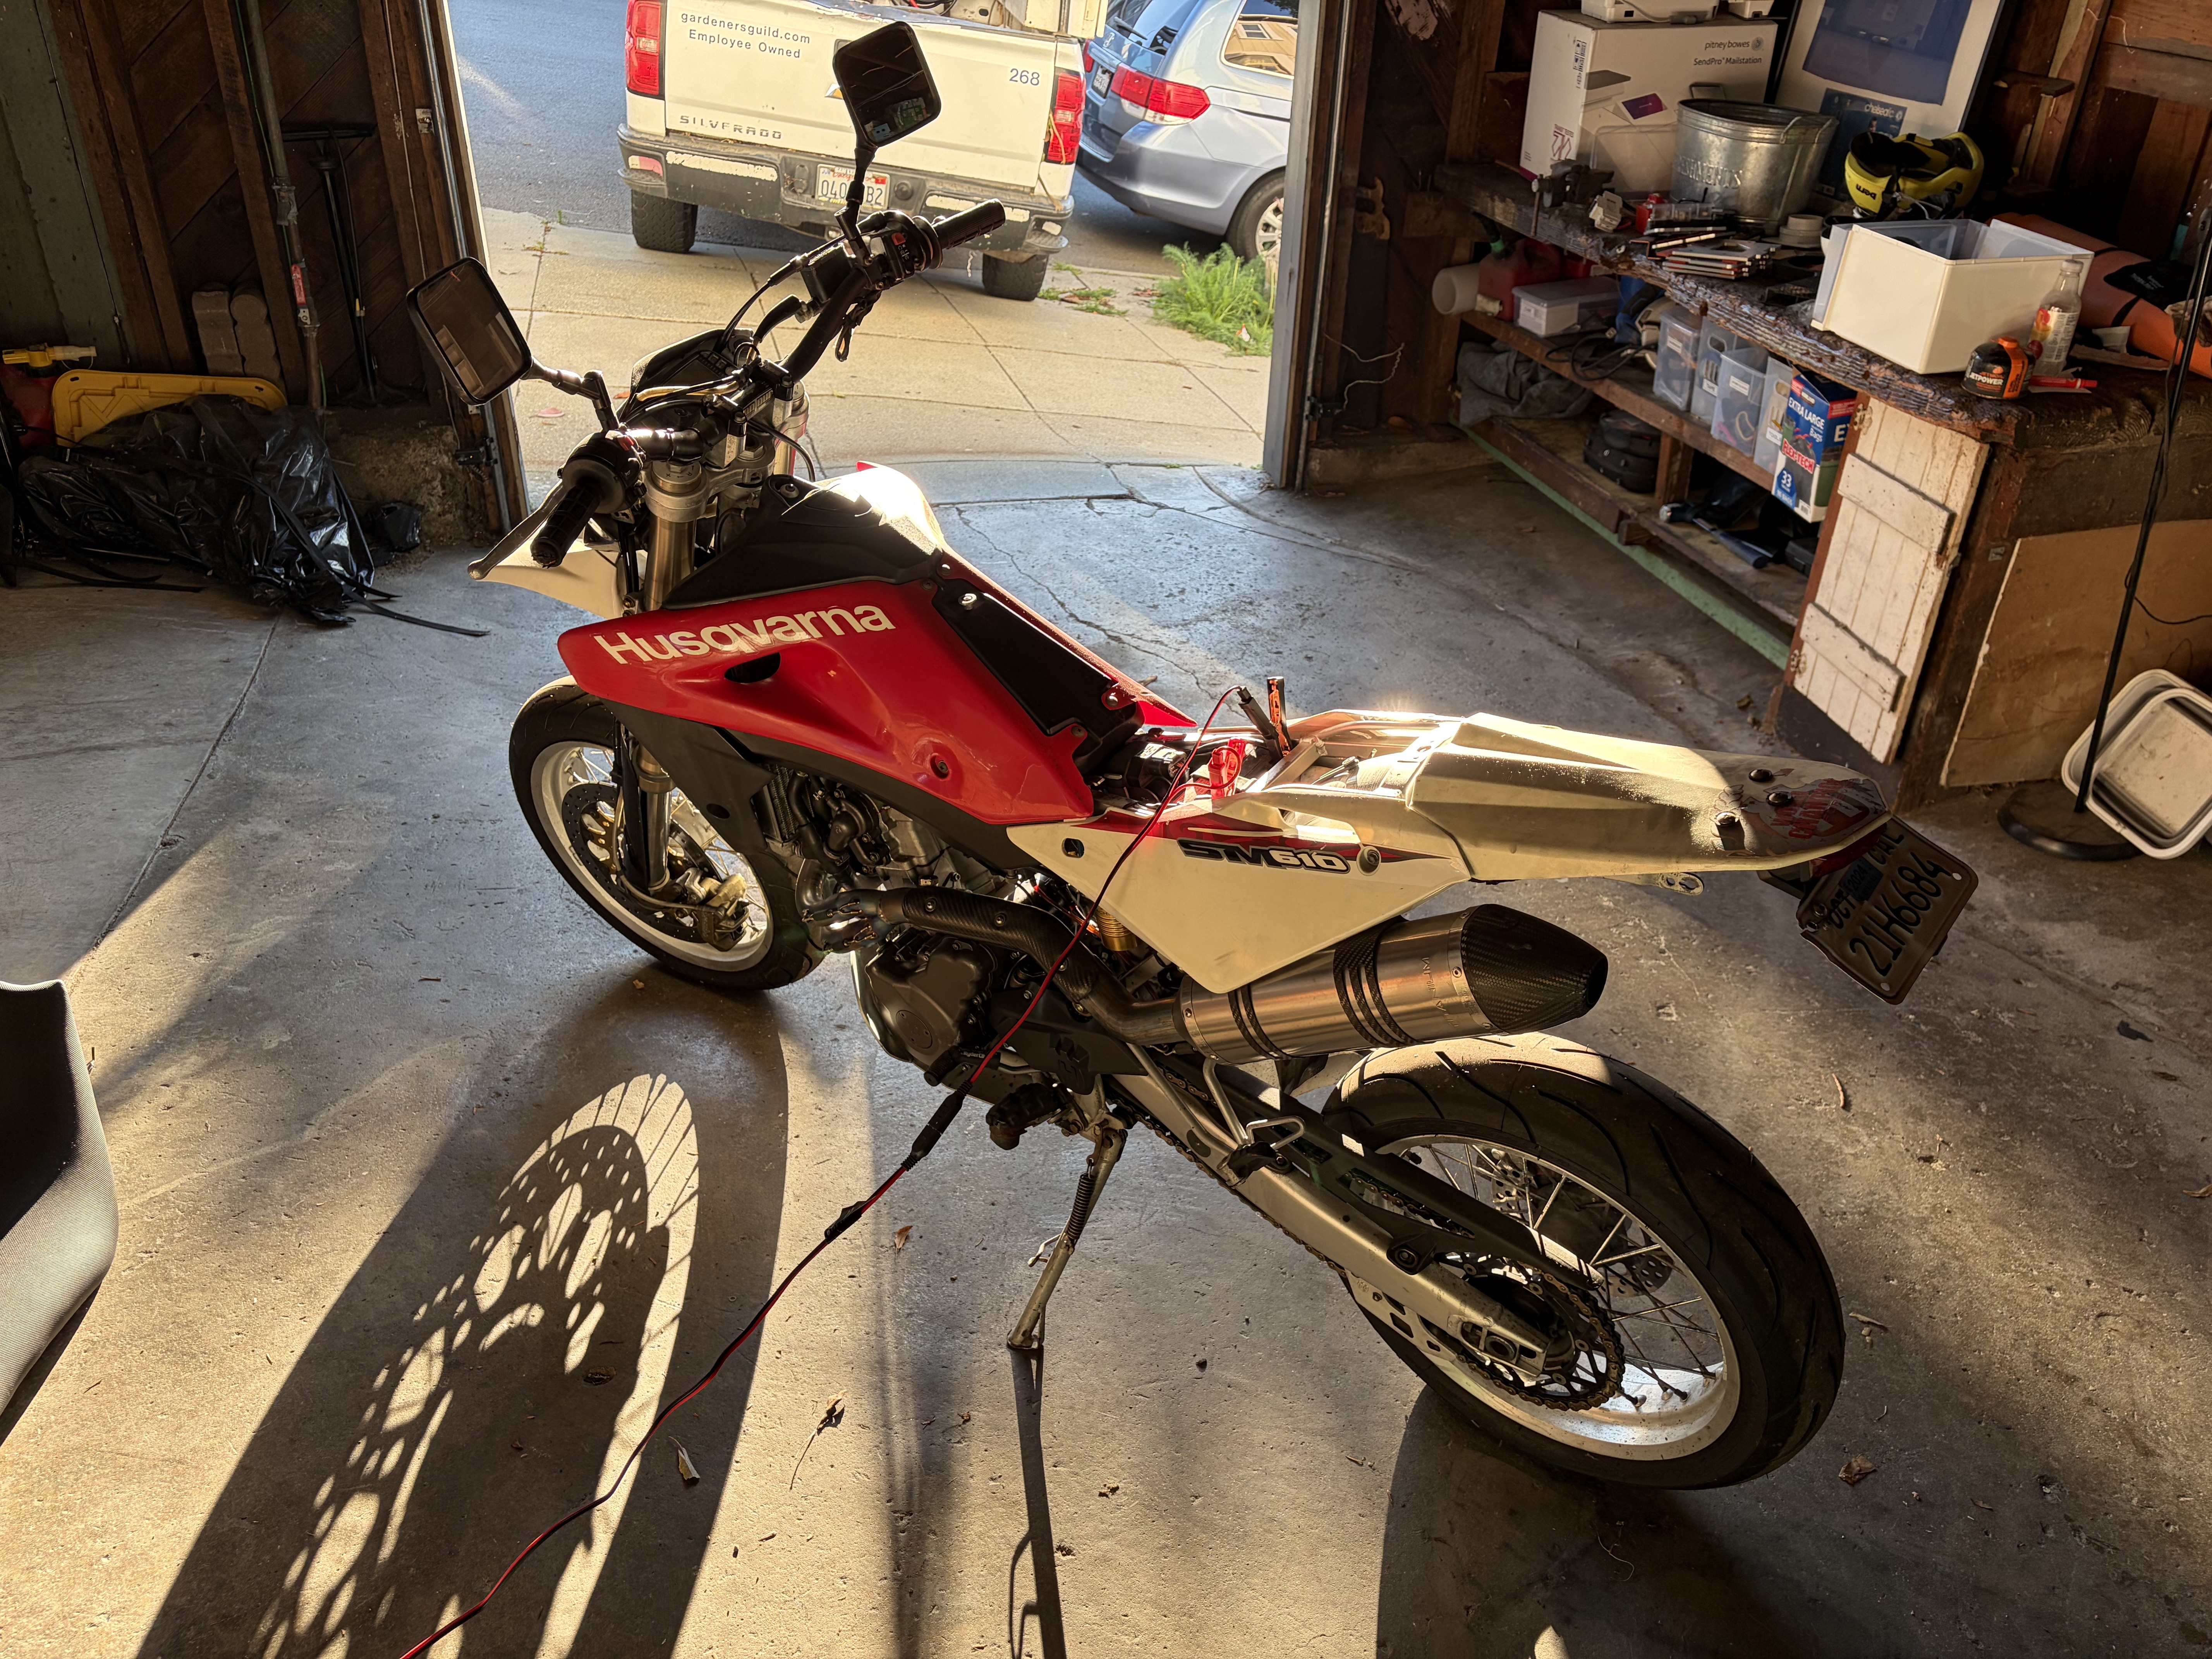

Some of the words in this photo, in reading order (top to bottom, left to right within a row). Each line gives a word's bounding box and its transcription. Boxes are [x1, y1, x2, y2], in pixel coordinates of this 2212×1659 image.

[681, 13, 810, 44] gardenersguild.com
[689, 29, 751, 49] Employee
[758, 42, 800, 58] Owned
[1705, 40, 1727, 51] pitney
[1728, 40, 1750, 48] bowes
[1725, 57, 1762, 65] Mailstation
[1009, 68, 1040, 86] 268
[680, 115, 781, 139] SILVERADO
[821, 179, 883, 206] 040B2
[1788, 397, 1804, 417] EXTRA
[1804, 409, 1825, 430] LARGE
[1781, 470, 1792, 488] 33
[593, 605, 896, 665] Husqvarna
[1176, 837, 1351, 874] SM610
[1829, 889, 1856, 929] OCT
[1846, 862, 1867, 891] 2024
[1867, 834, 1905, 866] CAL
[1849, 852, 1952, 977] 21H6684
